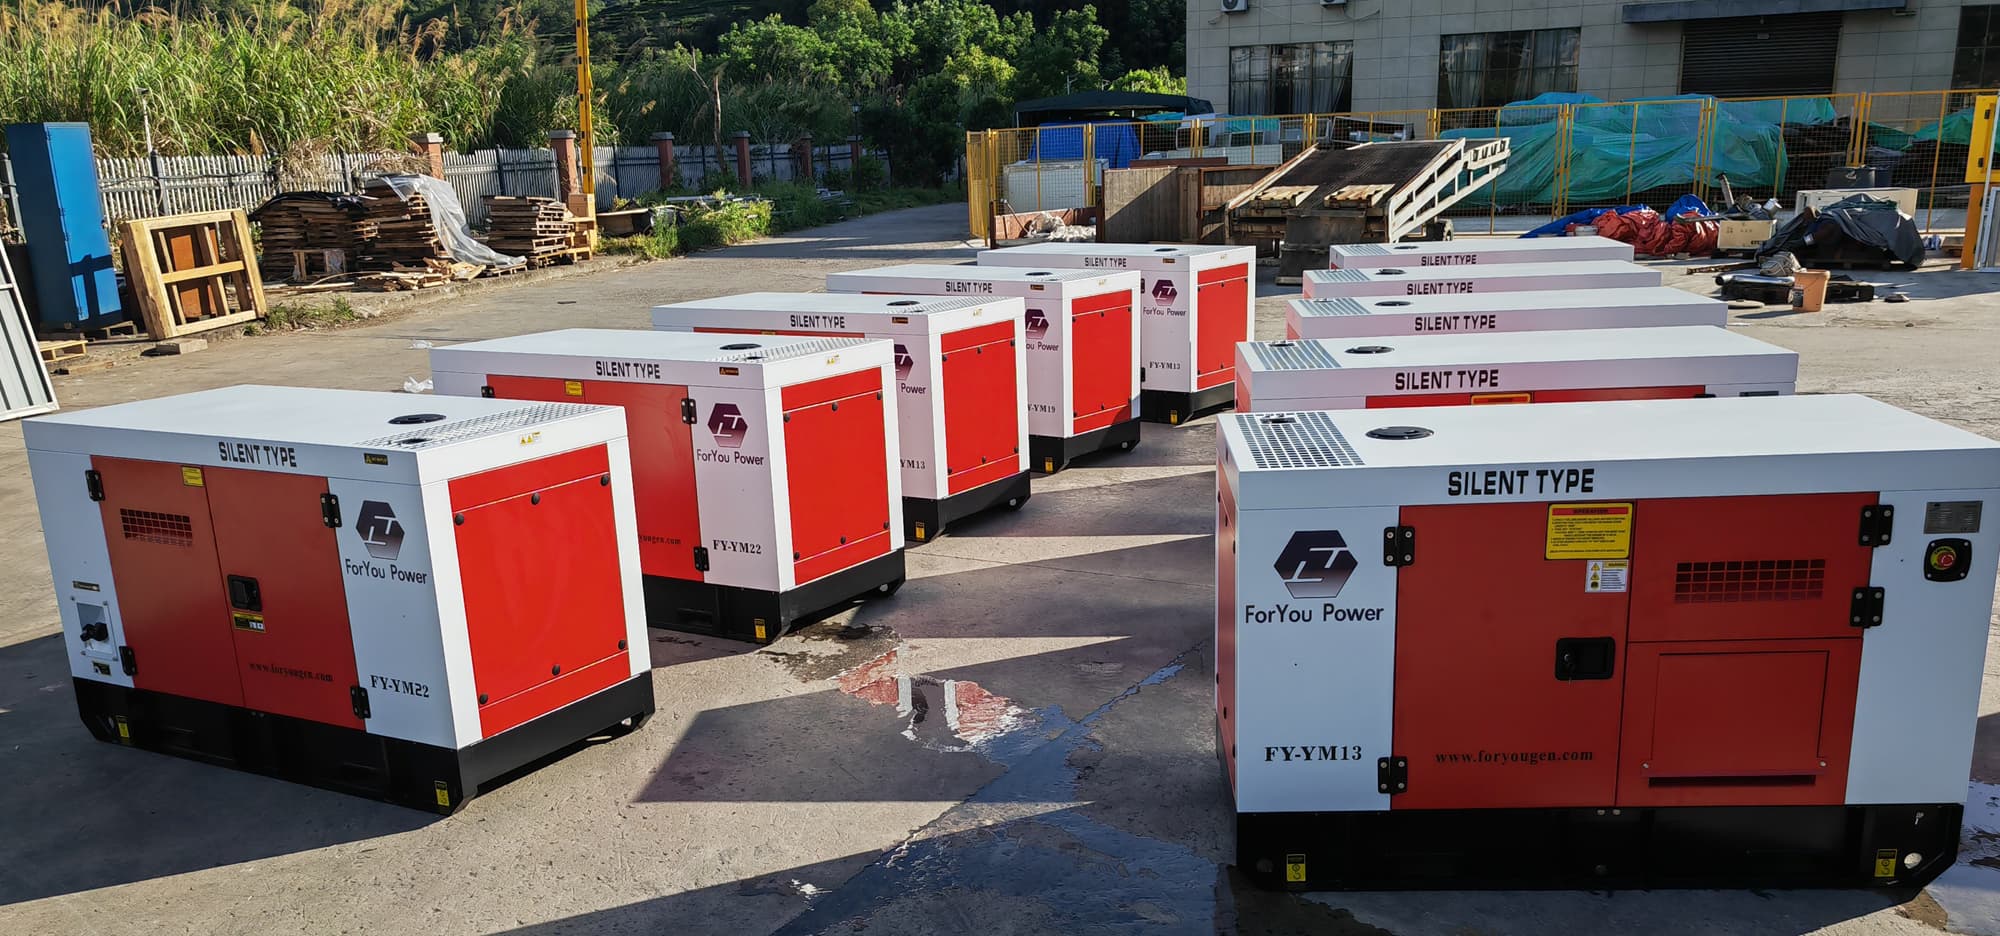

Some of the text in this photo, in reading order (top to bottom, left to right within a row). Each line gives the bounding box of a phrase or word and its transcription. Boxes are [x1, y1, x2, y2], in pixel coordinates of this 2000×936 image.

[1085, 257, 1127, 267] SILENT TYPE
[1421, 254, 1477, 266] SILENT TYPE
[946, 281, 992, 293] SILENT TYPE
[1407, 282, 1473, 295] SILENT TYPE
[1143, 307, 1186, 316] ForYou Power
[790, 315, 845, 328] SILENT TYPE
[1415, 315, 1496, 331] SILENT TYPE
[1037, 341, 1059, 351] Power
[595, 361, 660, 379] SILENT TYPE
[1395, 369, 1498, 390] SILENT TYPE
[901, 383, 926, 394] Power
[218, 441, 297, 467] SILENT TYPE
[696, 449, 764, 466] ForYou Power
[1448, 468, 1595, 496] SILENT TYPE
[713, 539, 762, 555] FY-YM22
[345, 558, 428, 584] ForYou Power
[1245, 603, 1384, 623] ForYou Power
[370, 674, 430, 698] FY-YM22
[1264, 746, 1362, 762] FY-YM13
[1435, 750, 1594, 766] www.foryougen.com
